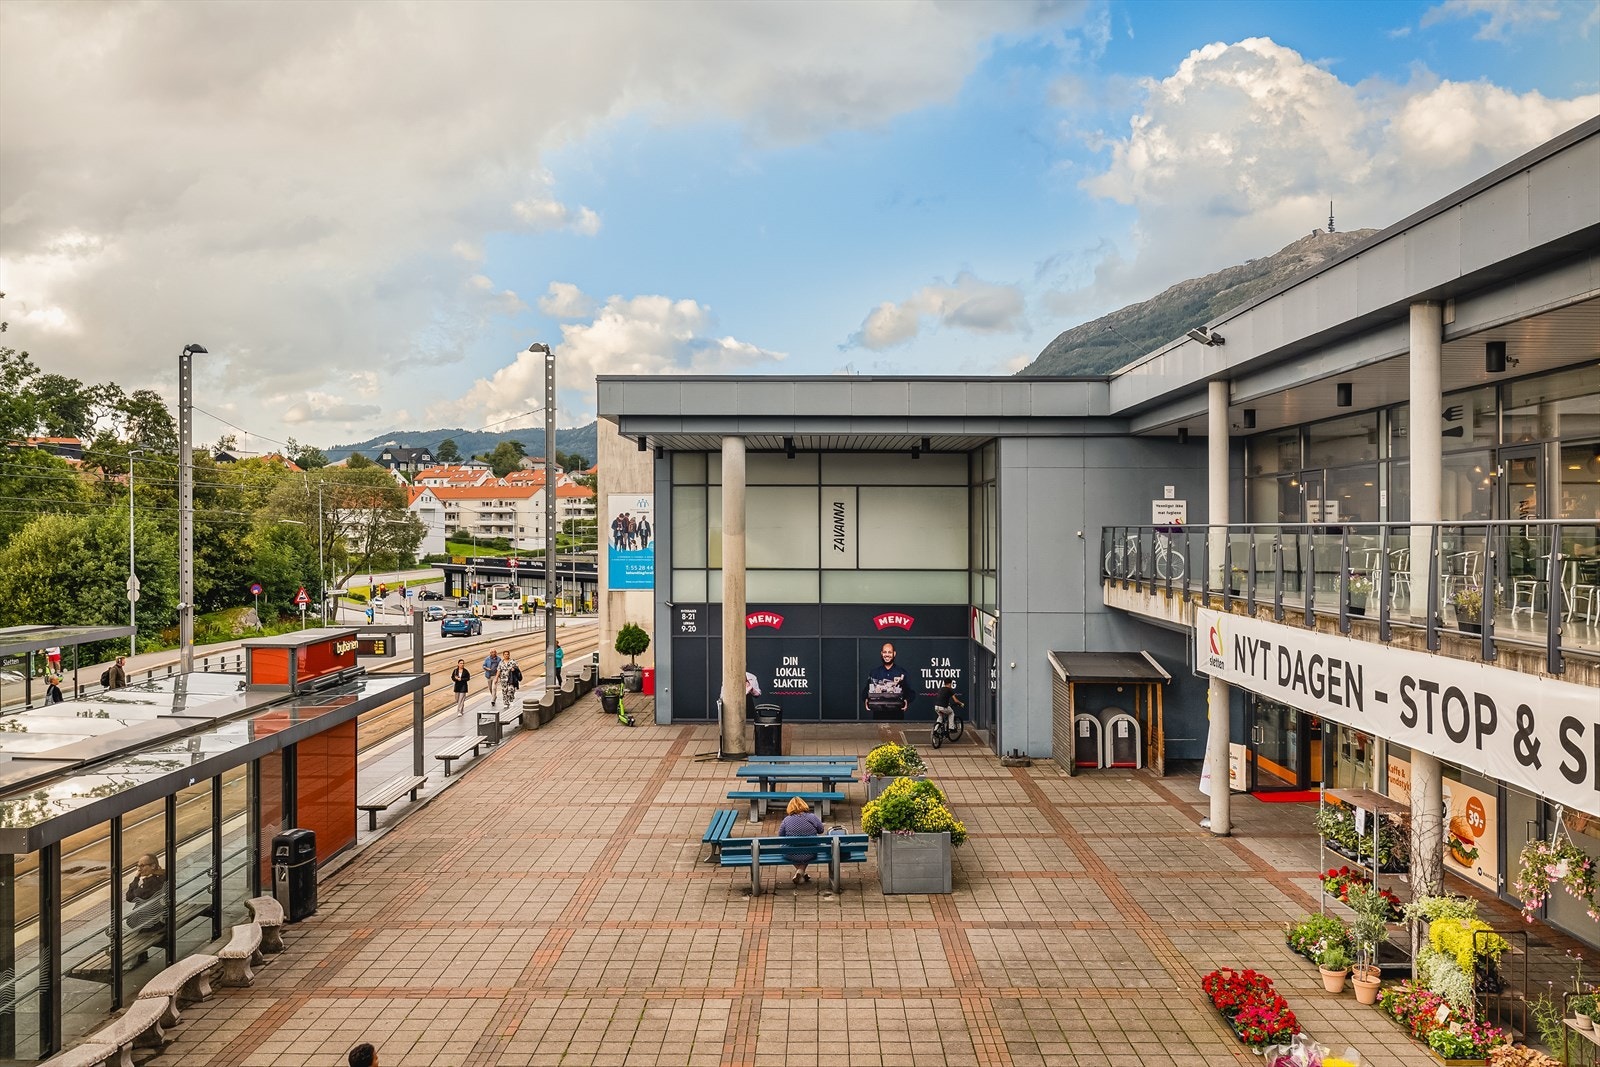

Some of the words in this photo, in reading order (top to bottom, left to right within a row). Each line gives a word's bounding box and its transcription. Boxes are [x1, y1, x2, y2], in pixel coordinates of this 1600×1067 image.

[833, 501, 845, 553] ZAVANNA
[748, 614, 780, 625] MENY
[878, 615, 910, 626] MENY
[336, 640, 359, 655] bybanen
[2, 658, 20, 666] Sletten
[782, 656, 798, 666] DIN
[931, 657, 939, 667] SI
[940, 657, 951, 667] JA
[1209, 657, 1225, 670] sletten
[775, 667, 806, 677] LOKALE
[920, 668, 933, 678] TIL
[934, 668, 961, 678] STORT
[773, 678, 808, 688] SLAKTER
[925, 680, 957, 690] UTVAG
[1234, 633, 1271, 681] NYT
[1278, 645, 1364, 713] DAGEN
[1399, 675, 1498, 751] STOP
[1513, 703, 1542, 771] &
[1559, 715, 1600, 791] S
